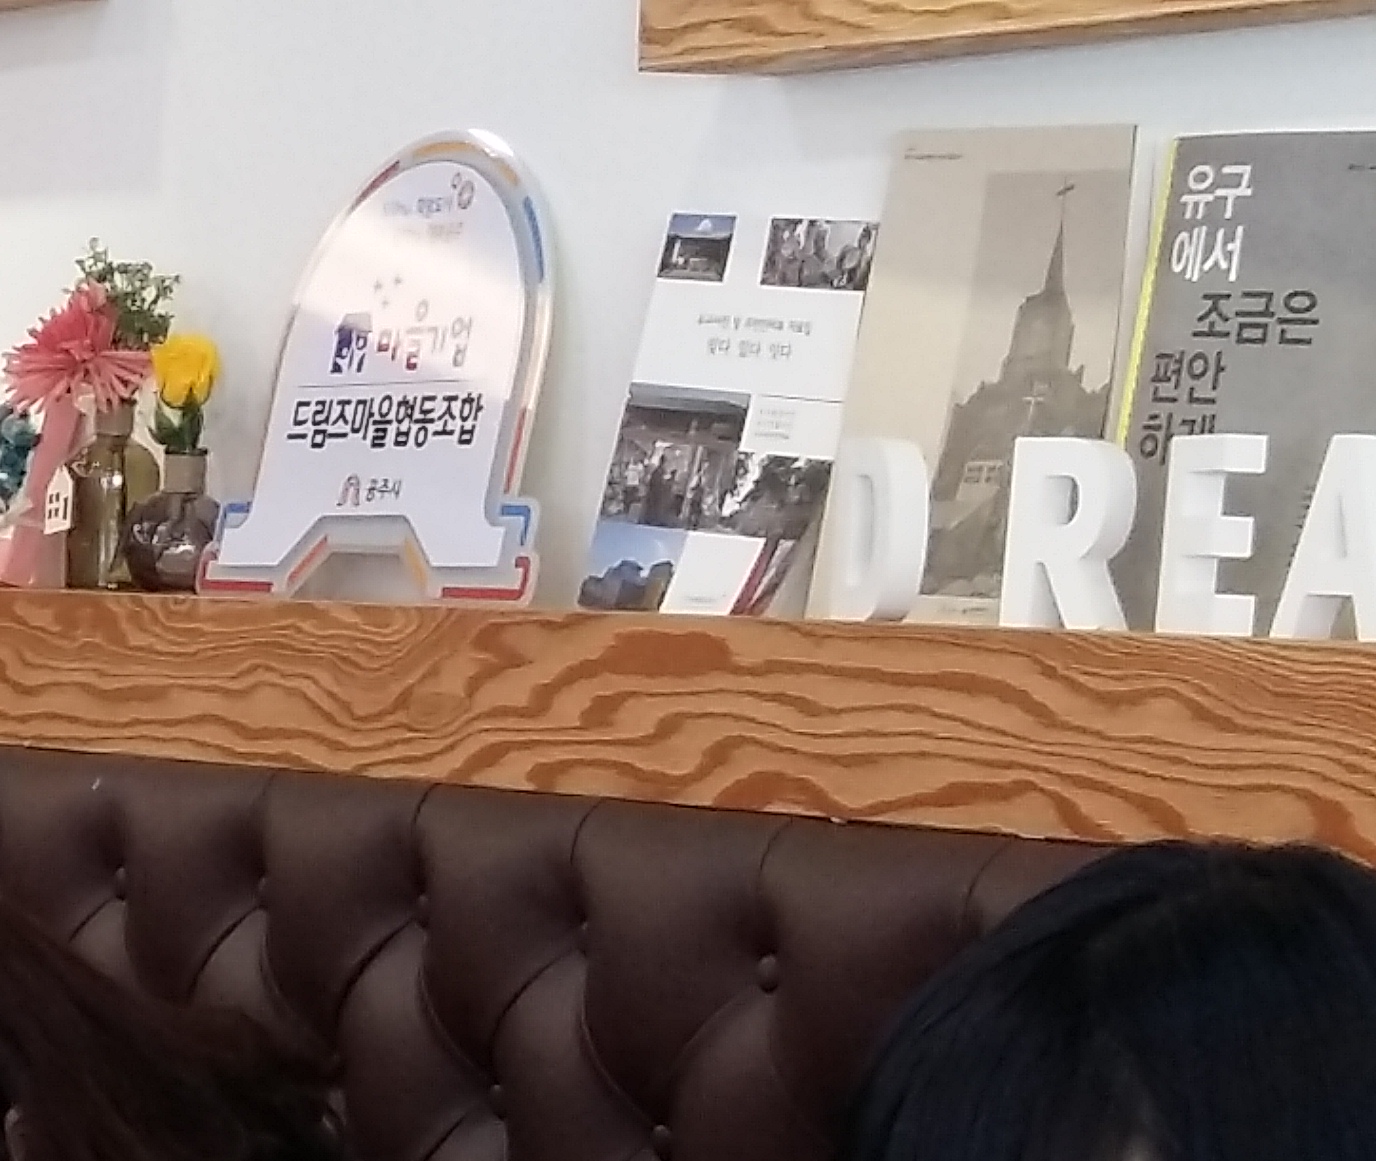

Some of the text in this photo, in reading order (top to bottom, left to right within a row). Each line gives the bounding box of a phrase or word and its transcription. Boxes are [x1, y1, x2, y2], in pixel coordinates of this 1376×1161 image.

[1180, 164, 1252, 219] 유구
[1169, 225, 1245, 282] 에서
[376, 299, 473, 371] 마을기업
[1191, 289, 1320, 345] 조금은
[1150, 350, 1227, 405] 편안
[286, 393, 484, 449] 드림즈마을협동조합
[366, 478, 402, 502] 공주시
